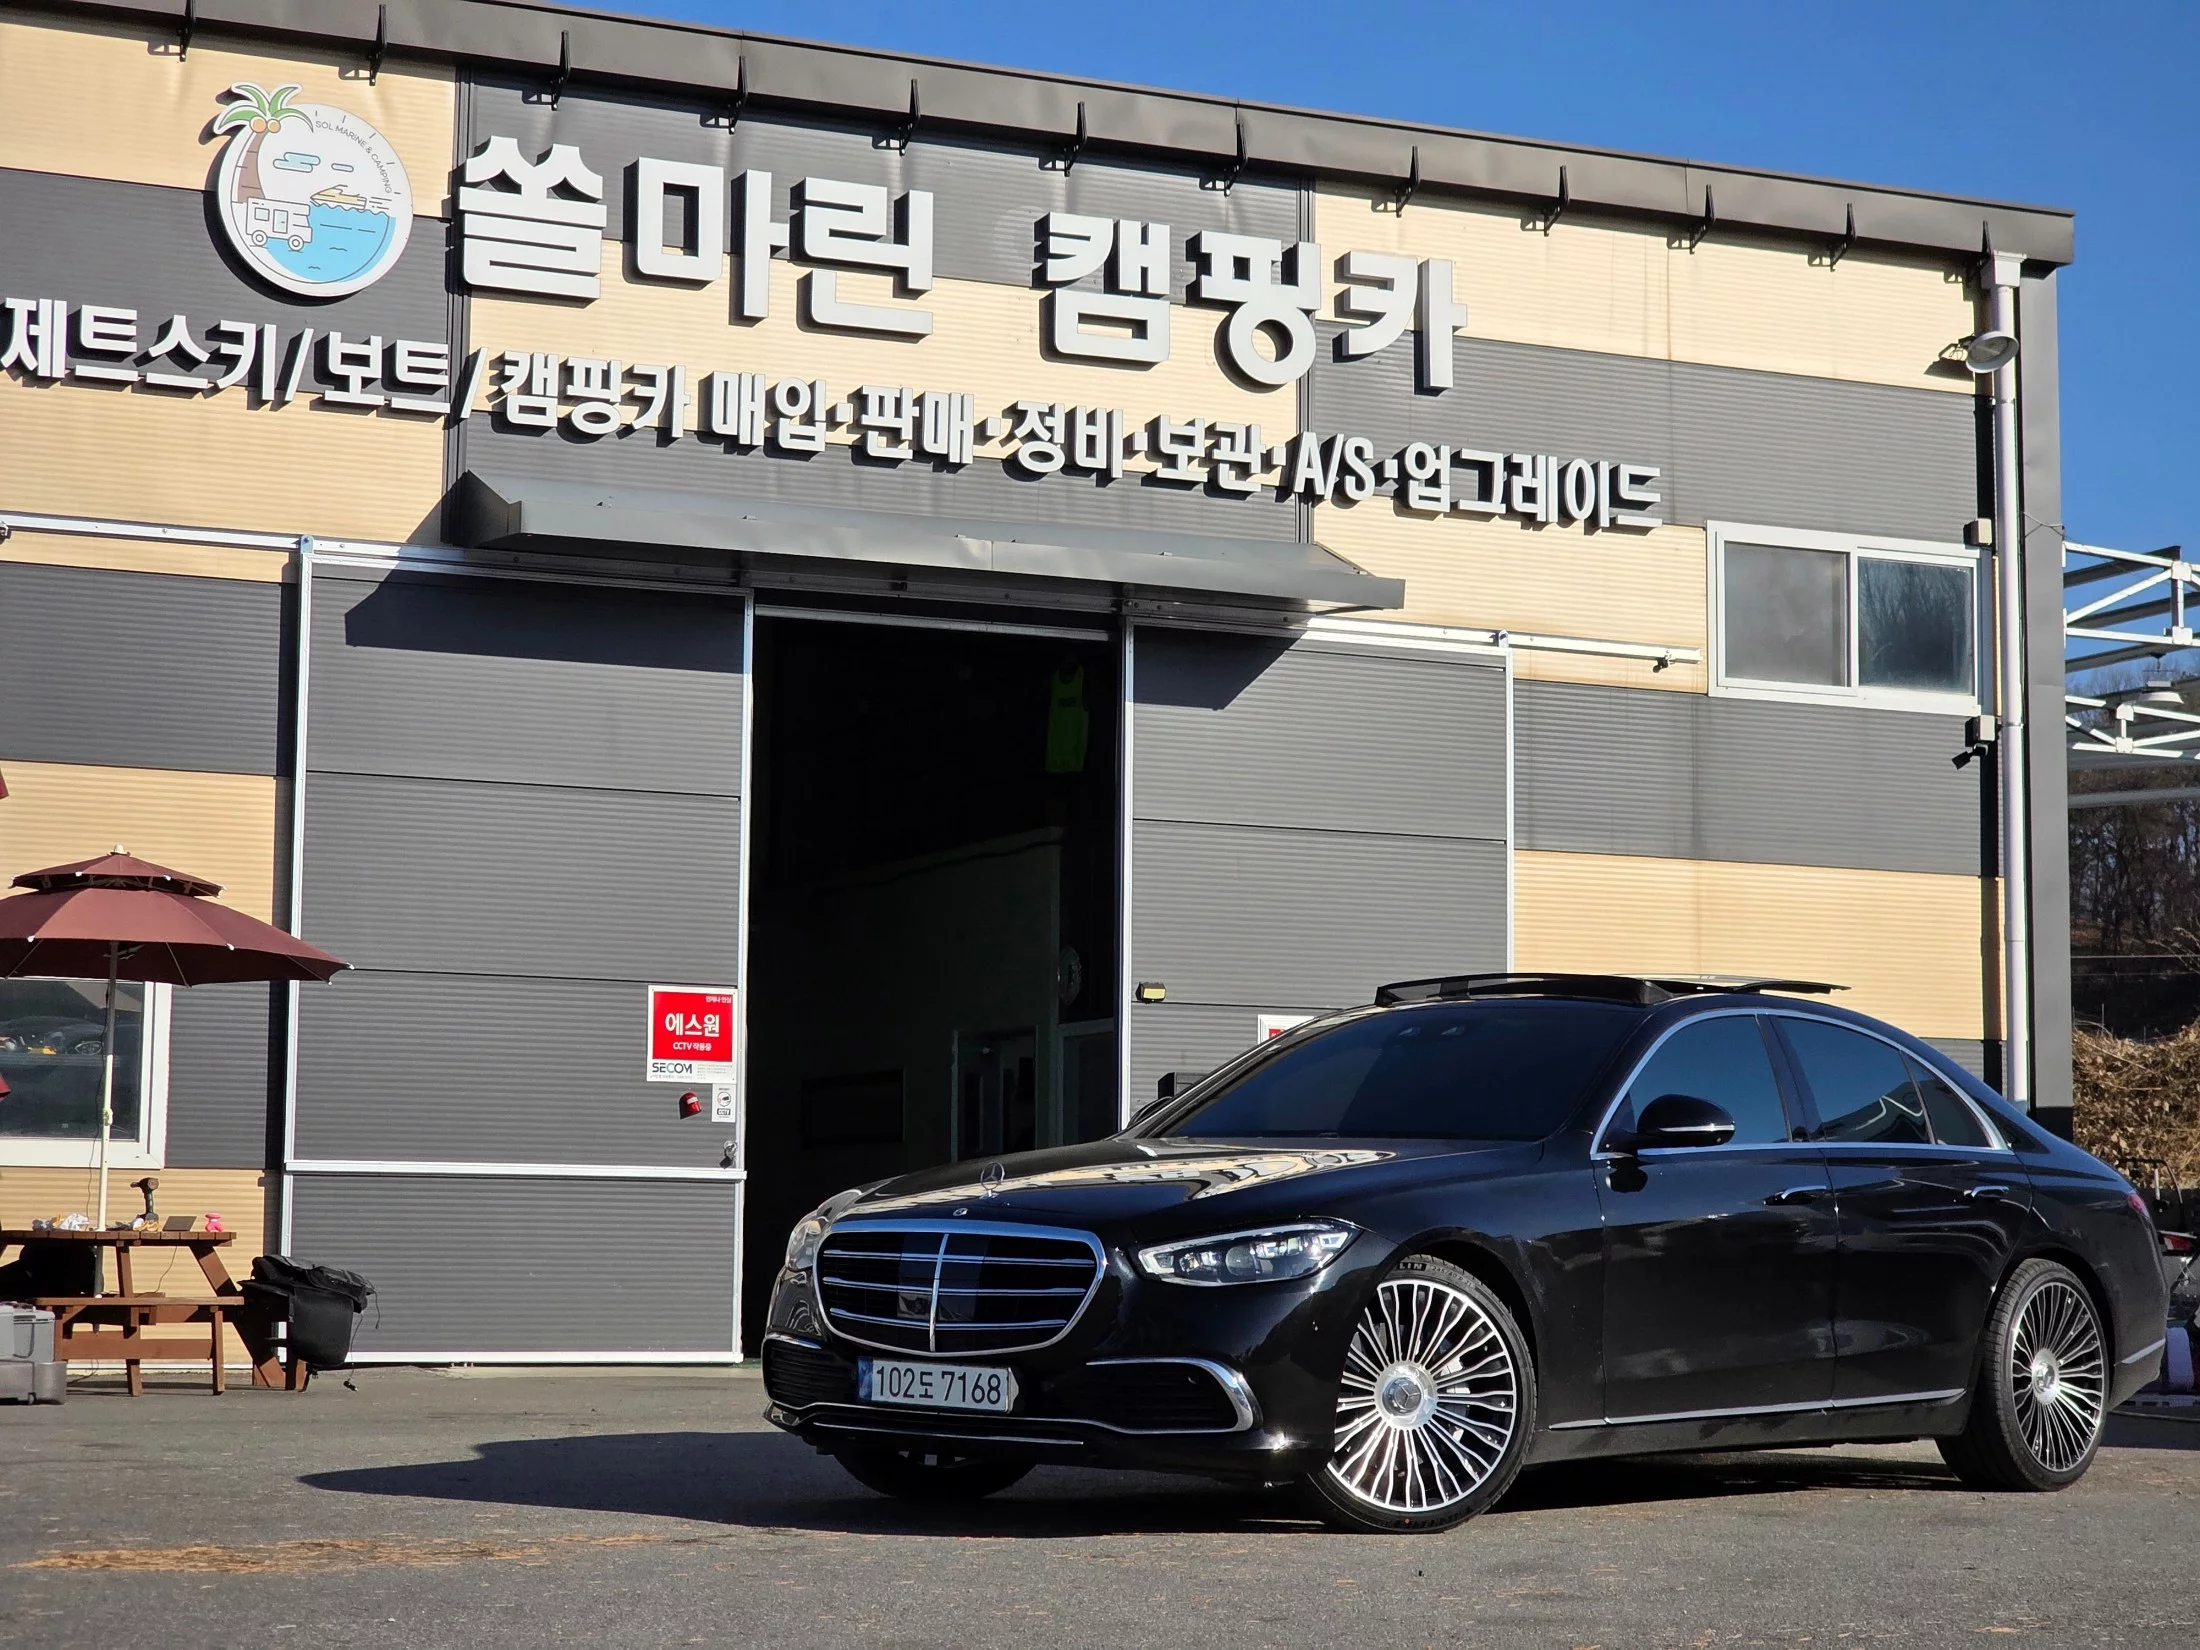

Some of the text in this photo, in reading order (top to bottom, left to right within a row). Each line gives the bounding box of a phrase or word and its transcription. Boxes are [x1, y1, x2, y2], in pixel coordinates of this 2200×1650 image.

[315, 120, 392, 194] SOL MARINE & CAMPING
[459, 135, 1467, 389] 쏠마린 캠핑카
[665, 1012, 720, 1038] 에스원
[672, 1041, 712, 1052] CCTV 작동중
[652, 1062, 693, 1074] SECOM
[1399, 1262, 1423, 1270] LIN
